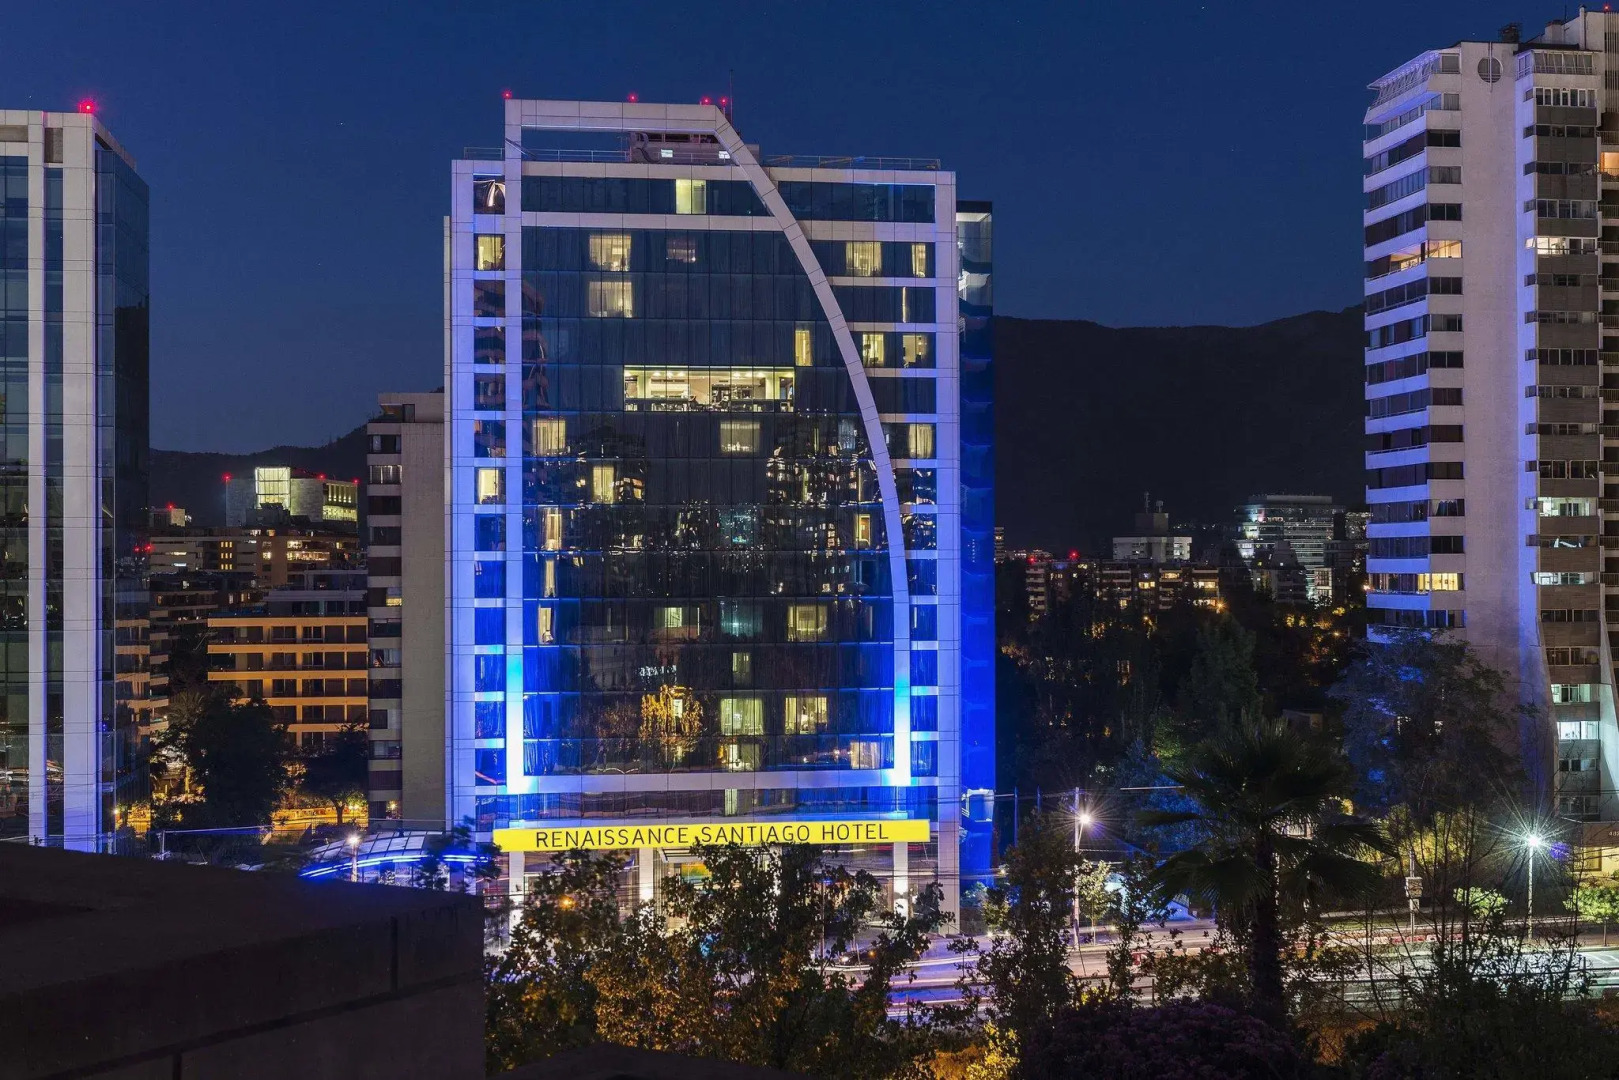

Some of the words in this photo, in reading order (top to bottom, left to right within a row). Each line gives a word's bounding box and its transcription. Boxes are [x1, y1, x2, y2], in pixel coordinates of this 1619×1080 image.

[536, 827, 689, 849] RENAISSANCE
[701, 825, 810, 843] SANTIAGO
[822, 824, 889, 841] HOTEL
